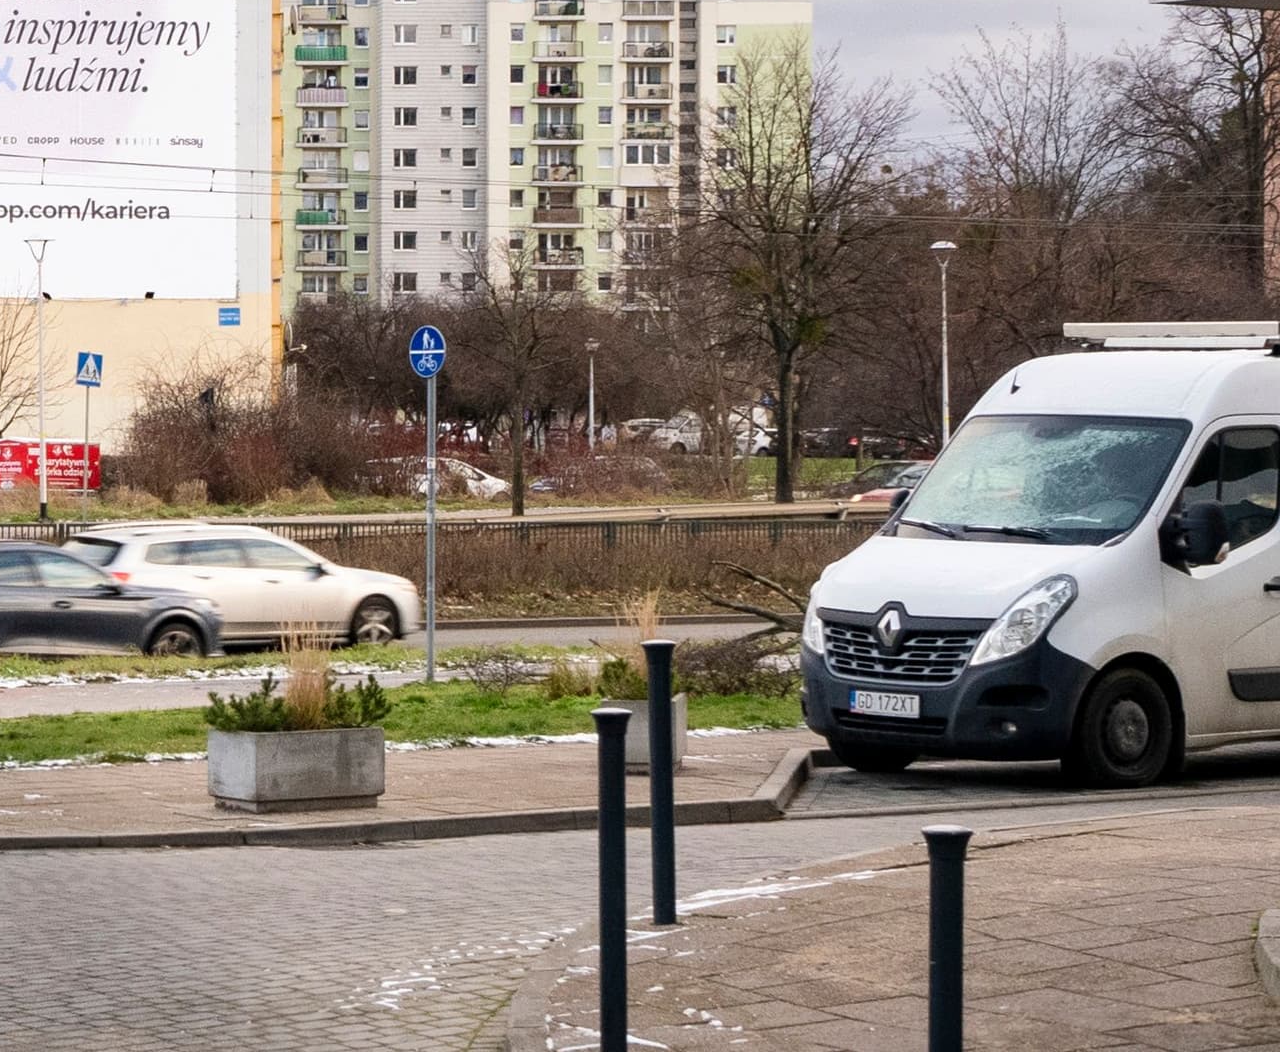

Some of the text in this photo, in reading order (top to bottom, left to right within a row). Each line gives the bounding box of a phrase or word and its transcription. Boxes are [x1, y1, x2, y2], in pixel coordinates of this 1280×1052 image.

[3, 9, 210, 57] inspirujemy
[22, 56, 149, 93] ludźmi.
[27, 136, 60, 145] CROPP
[857, 692, 917, 713] GD 172XT
